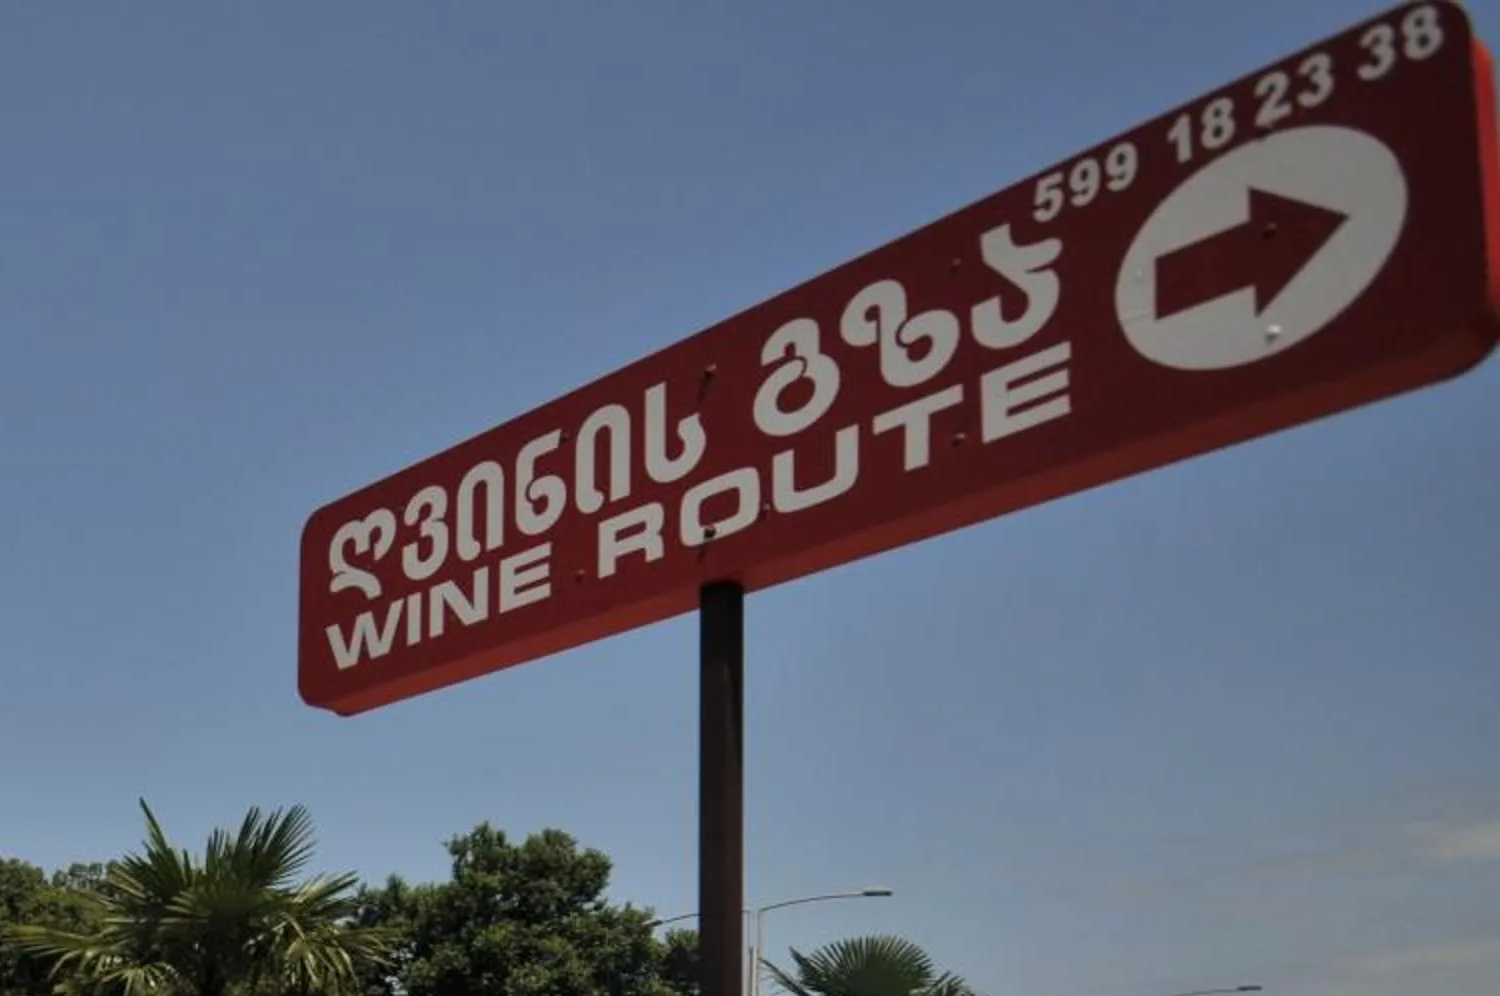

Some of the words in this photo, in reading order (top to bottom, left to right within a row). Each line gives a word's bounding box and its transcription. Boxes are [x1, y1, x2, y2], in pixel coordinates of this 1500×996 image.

[1032, 142, 1138, 222] 599
[1167, 98, 1235, 162] 18
[1255, 54, 1333, 126] 23
[1358, 6, 1442, 80] 38
[326, 542, 552, 670] WINE
[598, 342, 1071, 579] ROUTE
[329, 382, 706, 599] ღვინის
[753, 224, 1062, 437] გზა
